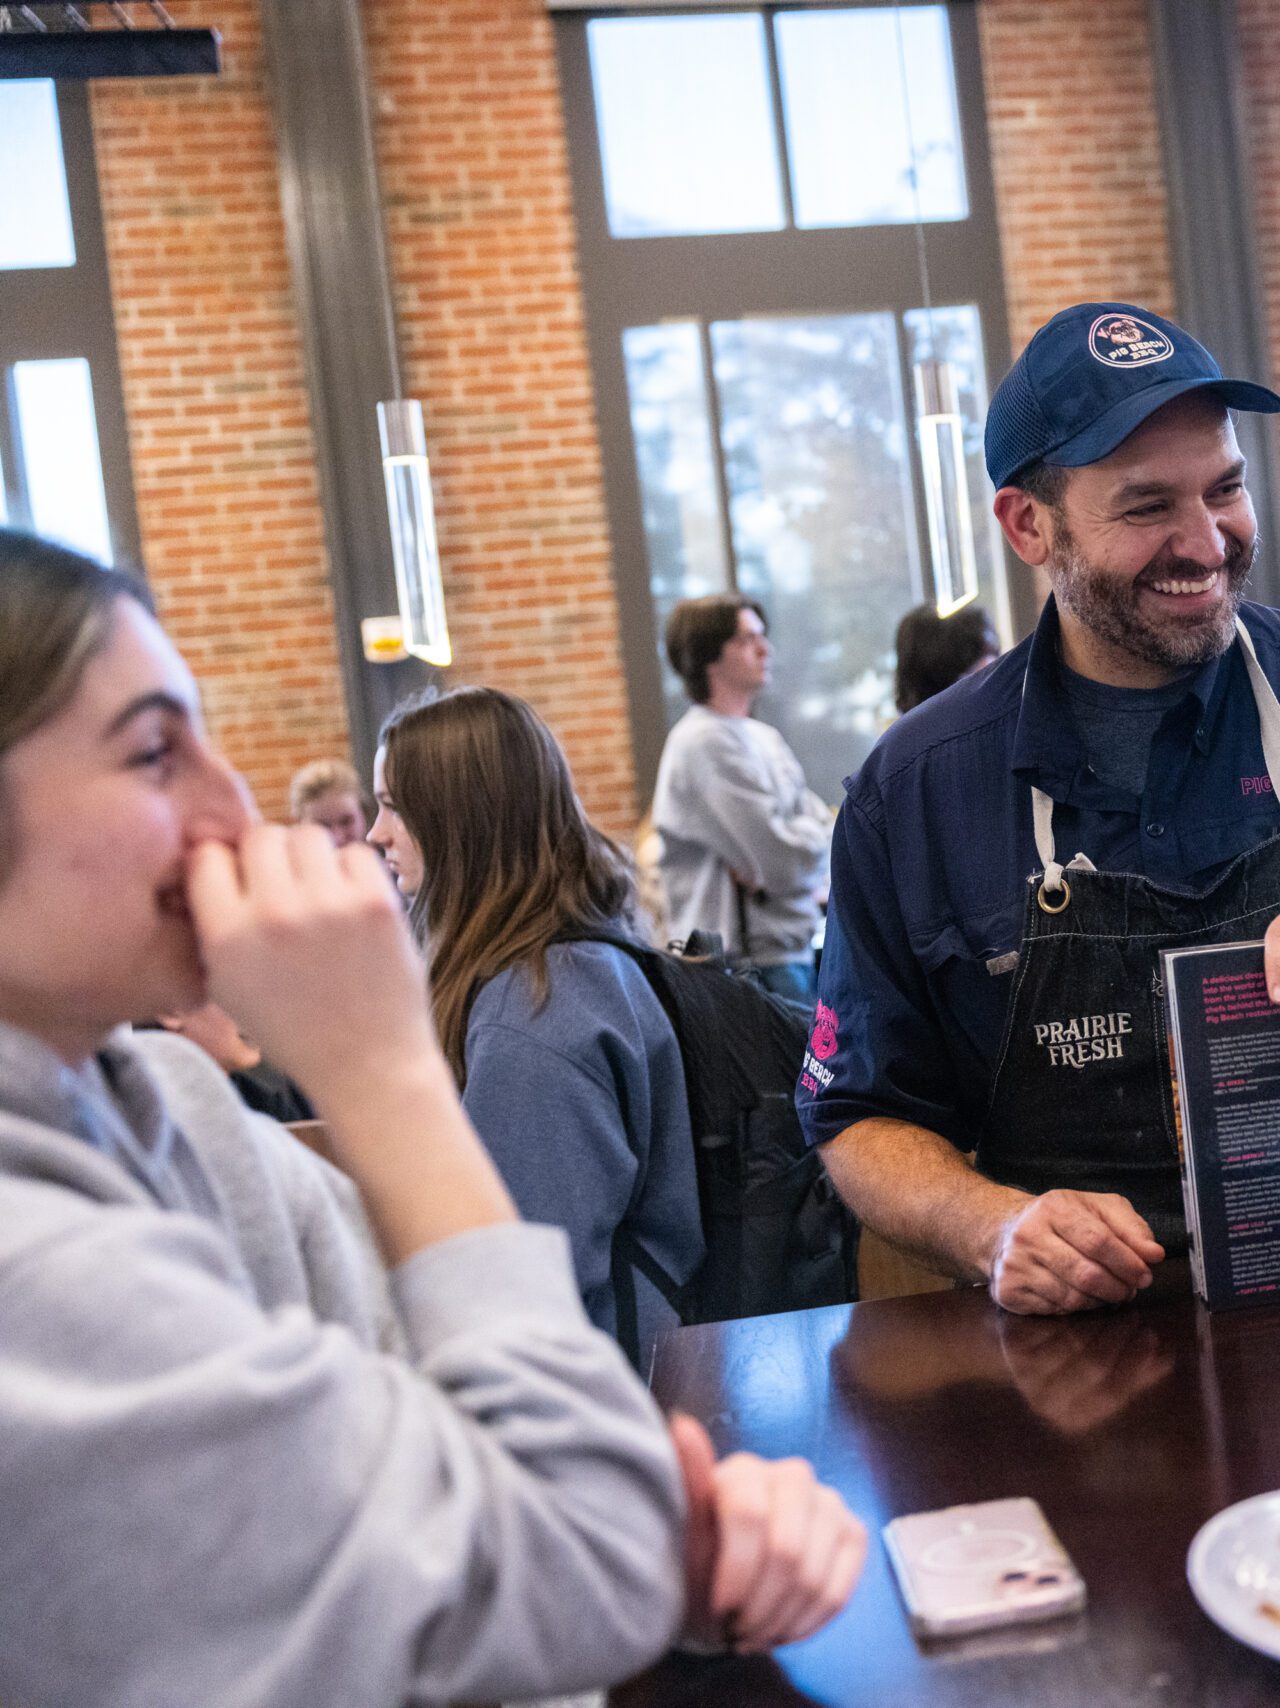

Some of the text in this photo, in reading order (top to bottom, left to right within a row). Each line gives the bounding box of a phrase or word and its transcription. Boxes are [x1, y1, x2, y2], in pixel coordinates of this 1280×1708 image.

[1108, 340, 1166, 360] PIG BEACH
[1209, 973, 1243, 984] delicious
[1202, 986, 1218, 994] into
[1219, 984, 1232, 992] the
[1233, 981, 1255, 990] world
[1203, 995, 1222, 1003] from
[1204, 1005, 1225, 1013] chefs
[1227, 1001, 1253, 1010] behind
[1205, 1015, 1219, 1024] Pig
[1220, 1012, 1244, 1021] Beach
[1034, 1012, 1132, 1044] PRAIRIE
[1048, 1036, 1124, 1069] FRESH
[809, 1057, 834, 1087] BEACH
